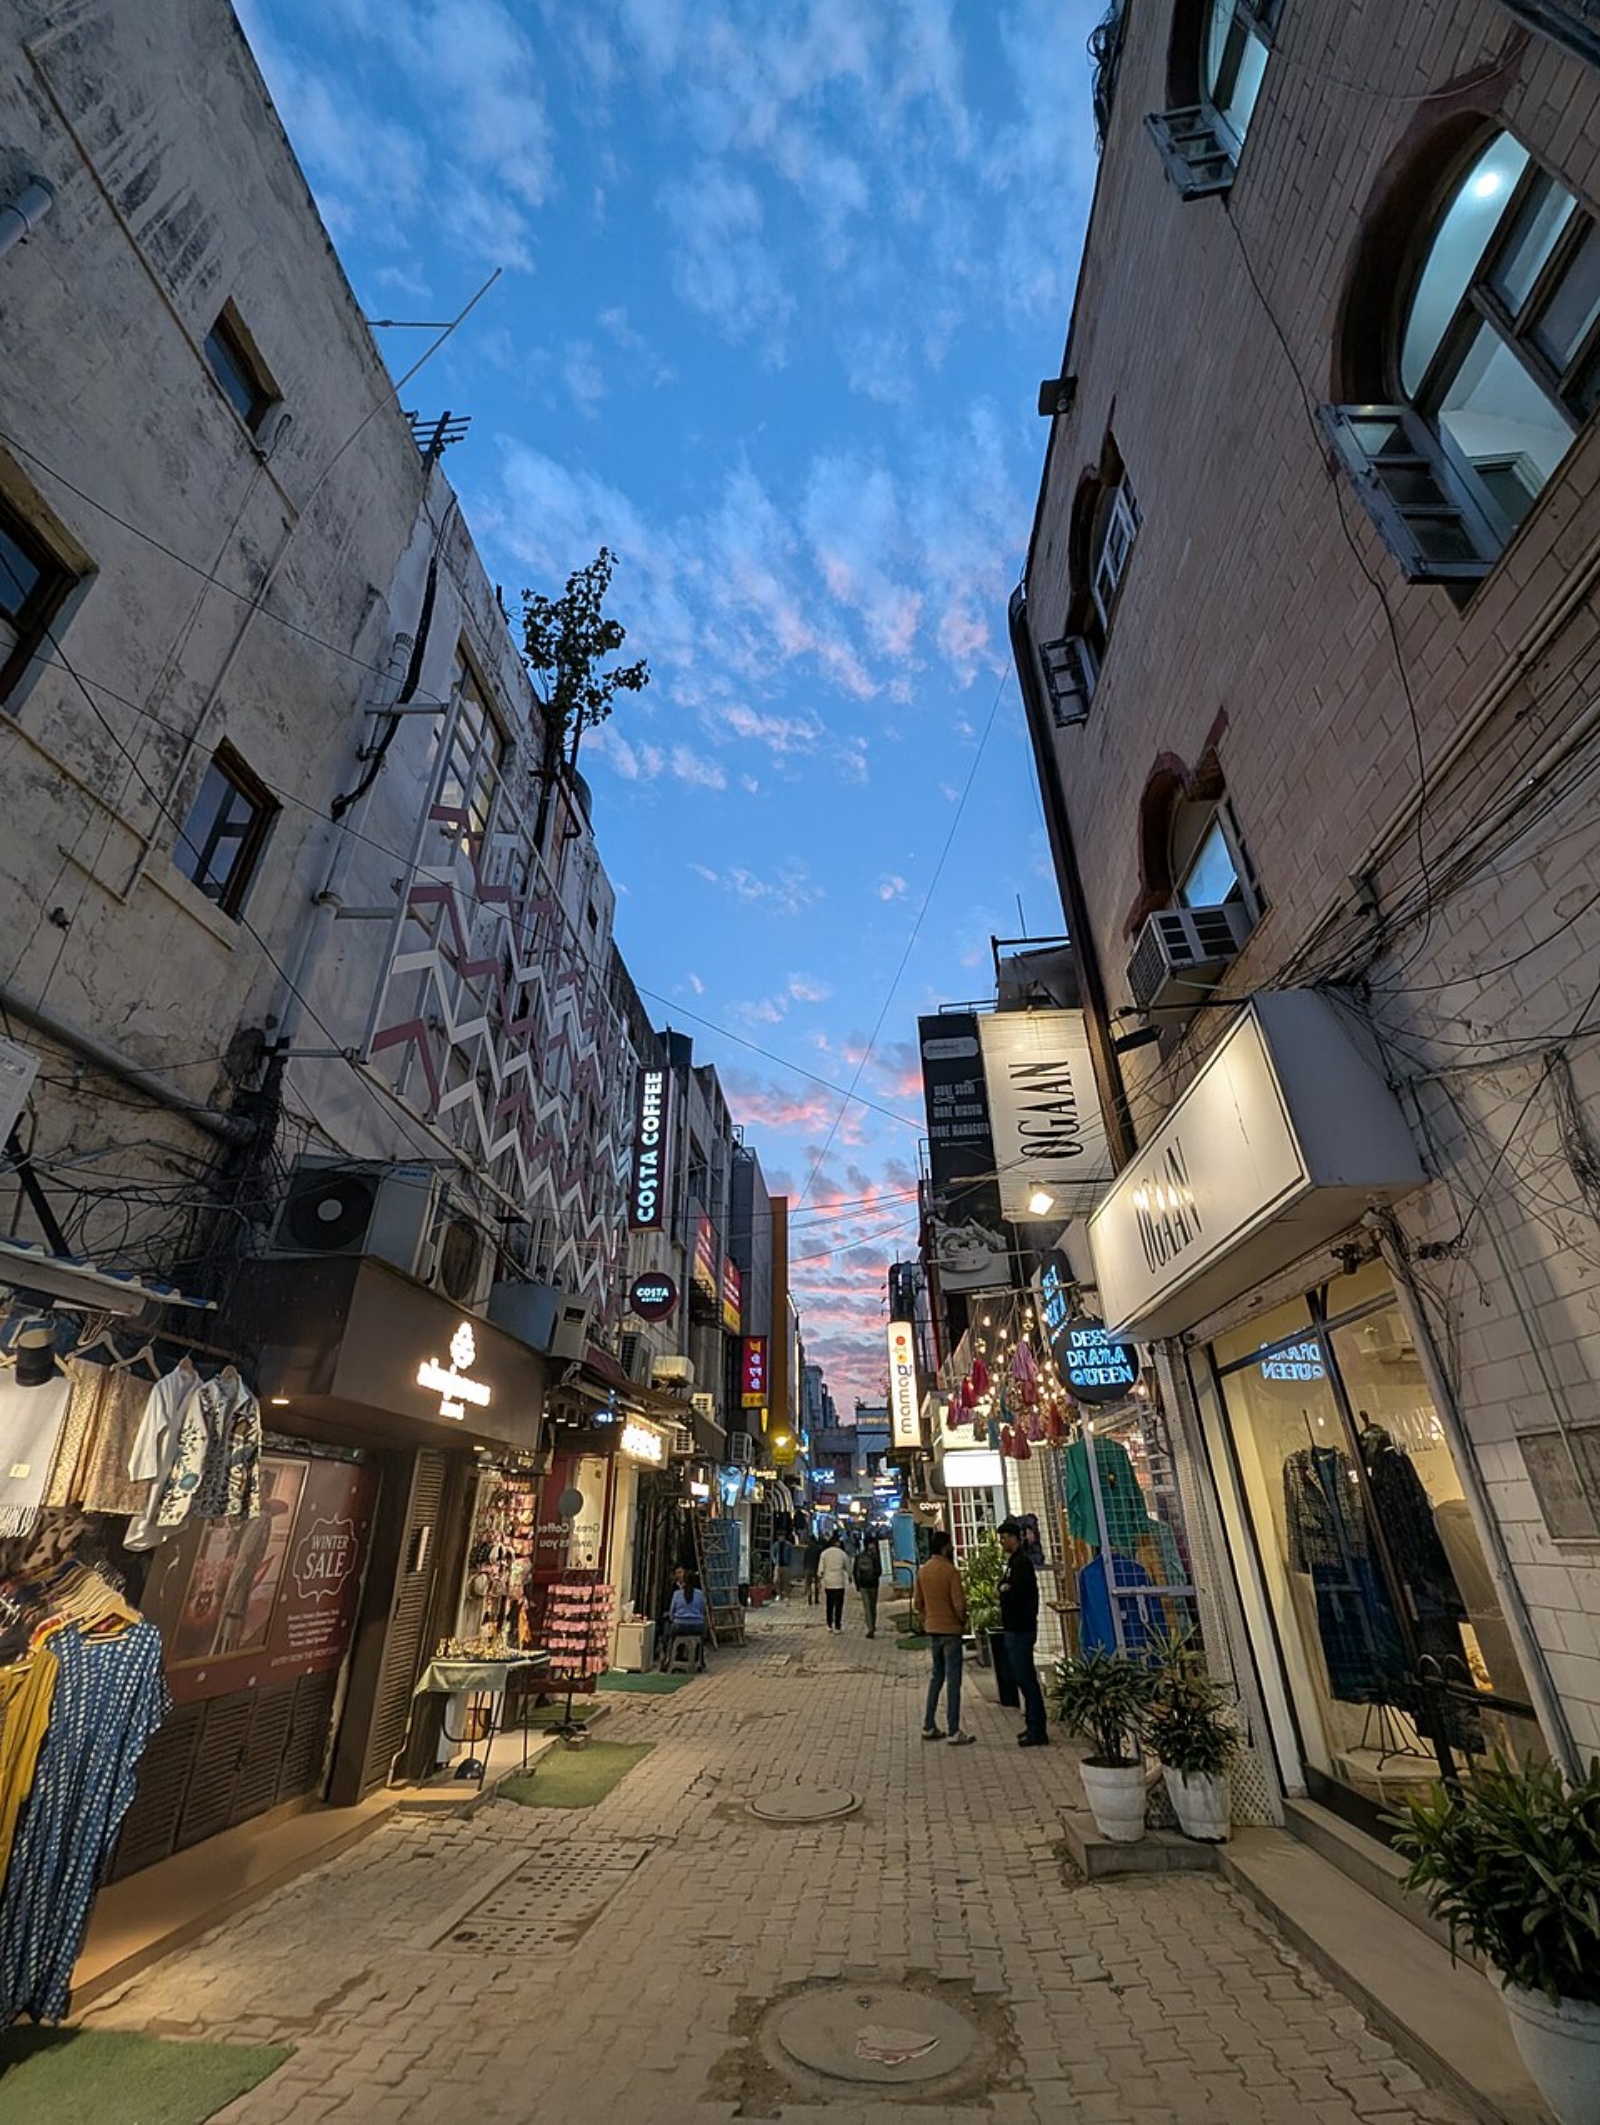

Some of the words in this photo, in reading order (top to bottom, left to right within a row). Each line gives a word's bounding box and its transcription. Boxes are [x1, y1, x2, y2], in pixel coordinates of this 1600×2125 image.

[641, 1071, 663, 1146] COFFEE
[1008, 1061, 1084, 1159] OGAAN
[636, 1149, 659, 1222] COSTA
[636, 1287, 669, 1298] COSTA
[1066, 1346, 1128, 1368] DRAMA
[1069, 1365, 1135, 1387] QUEEN
[311, 1534, 349, 1550] WINTER
[302, 1551, 347, 1580] SALE
